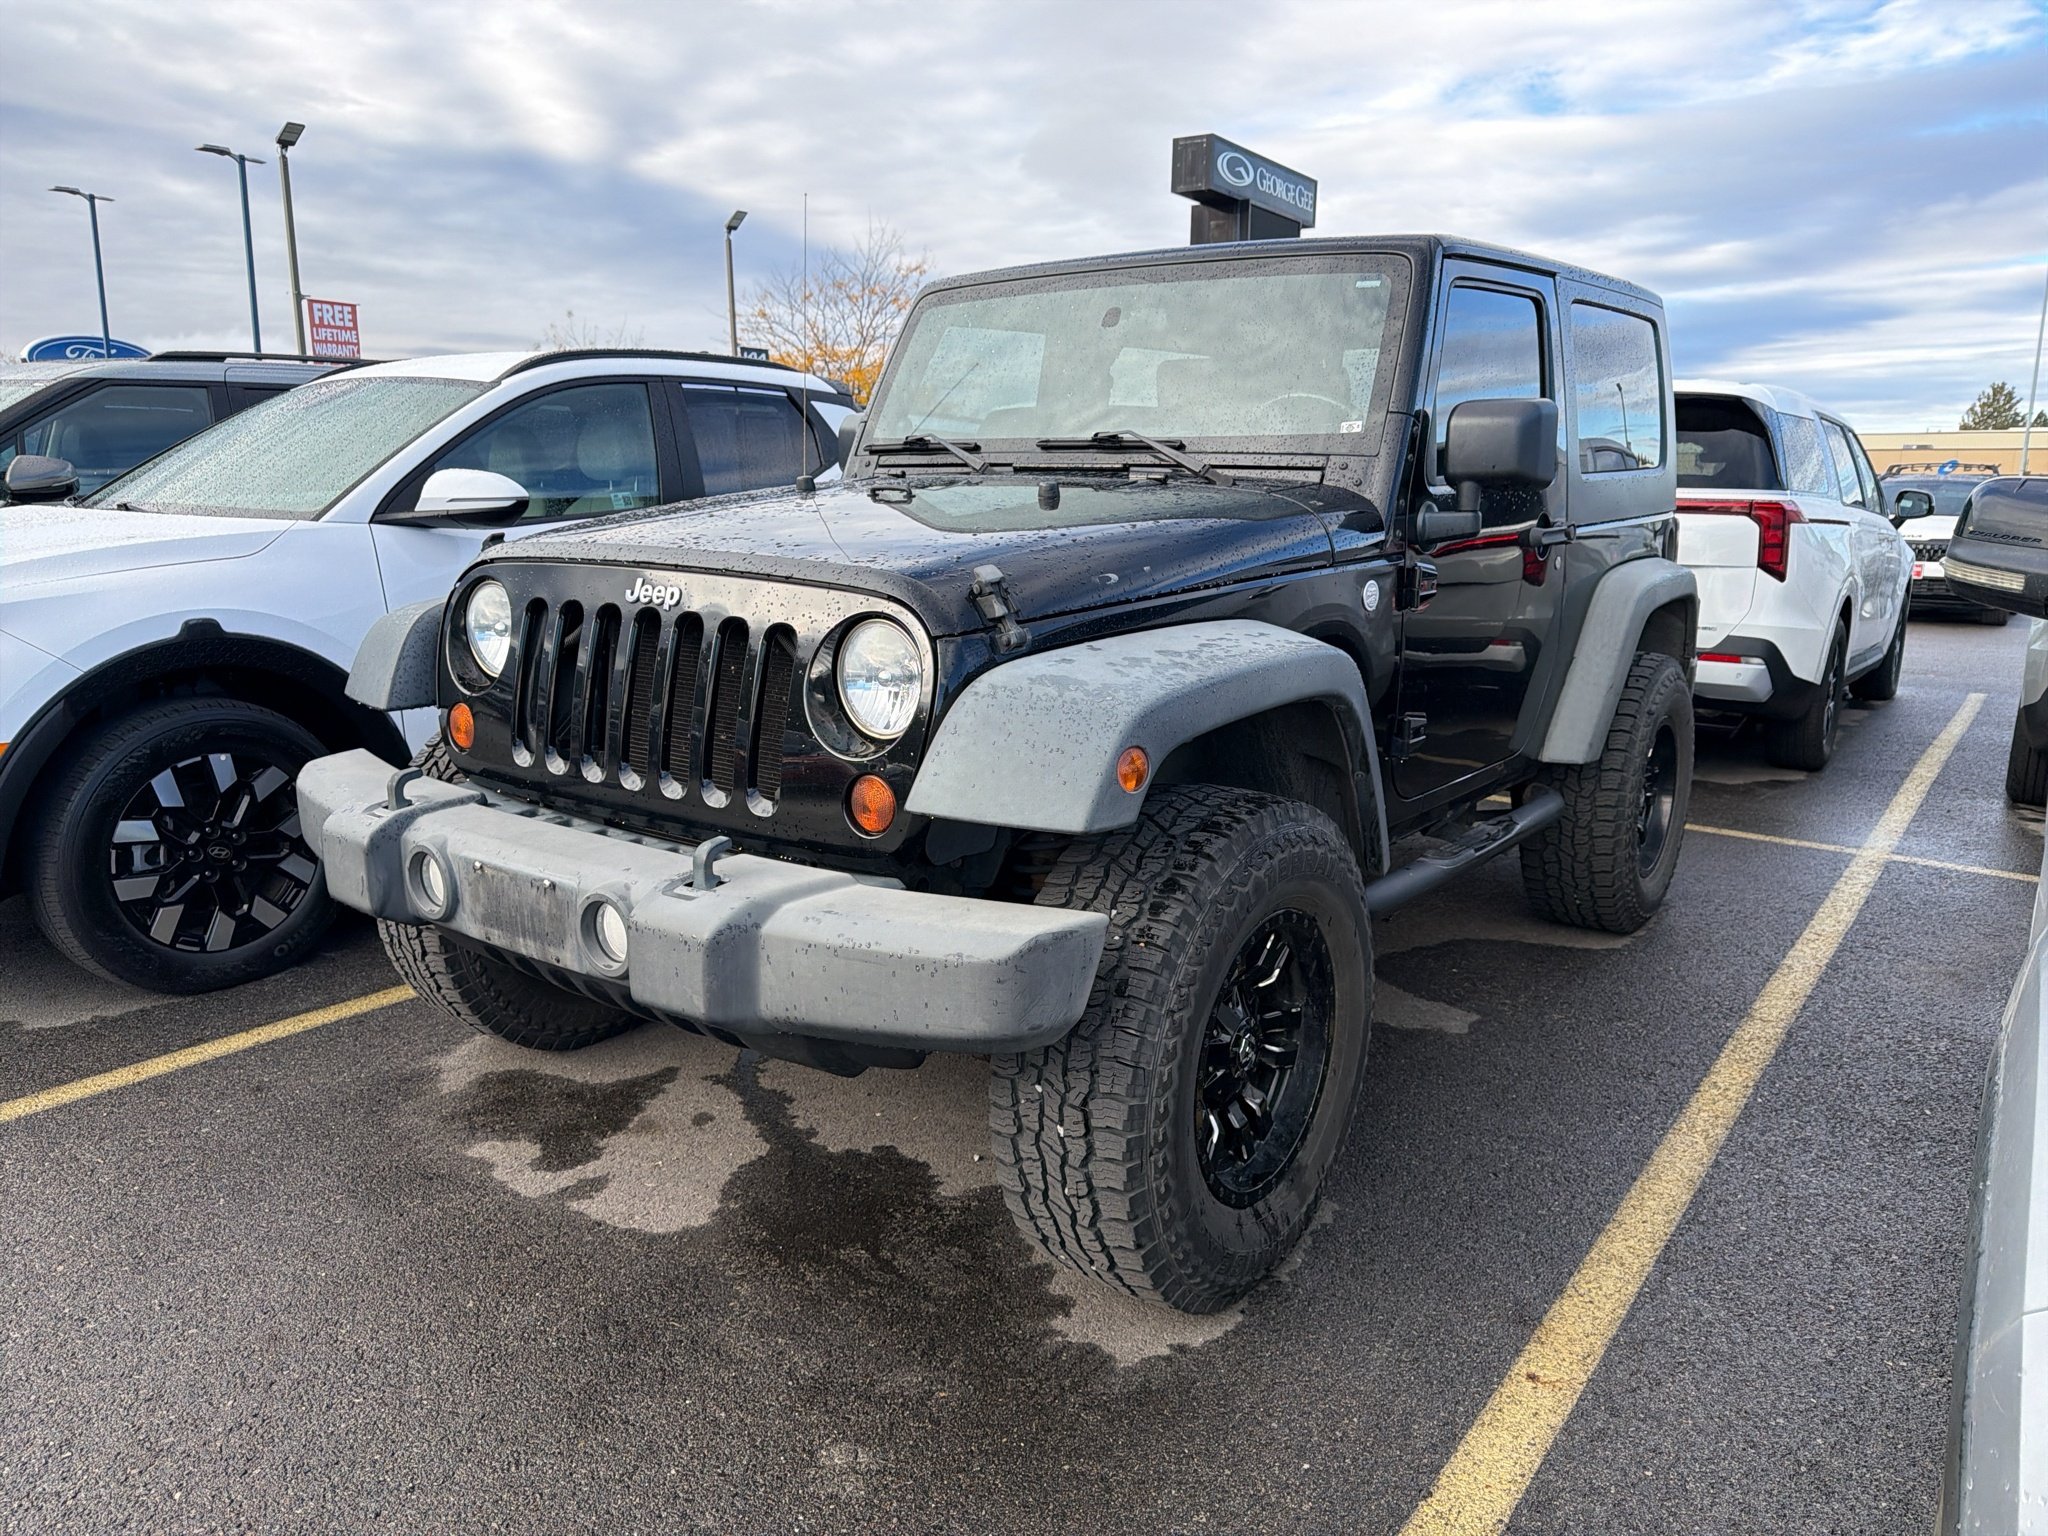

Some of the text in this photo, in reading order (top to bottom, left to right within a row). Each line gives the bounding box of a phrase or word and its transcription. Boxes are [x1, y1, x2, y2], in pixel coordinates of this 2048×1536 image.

[1256, 167, 1313, 211] GEORGE GEE
[312, 303, 354, 327] FREE
[313, 327, 358, 343] LIFETIME
[314, 342, 358, 358] WARRANTY
[1968, 530, 2043, 543] EXPLORER
[625, 577, 682, 611] Jeep
